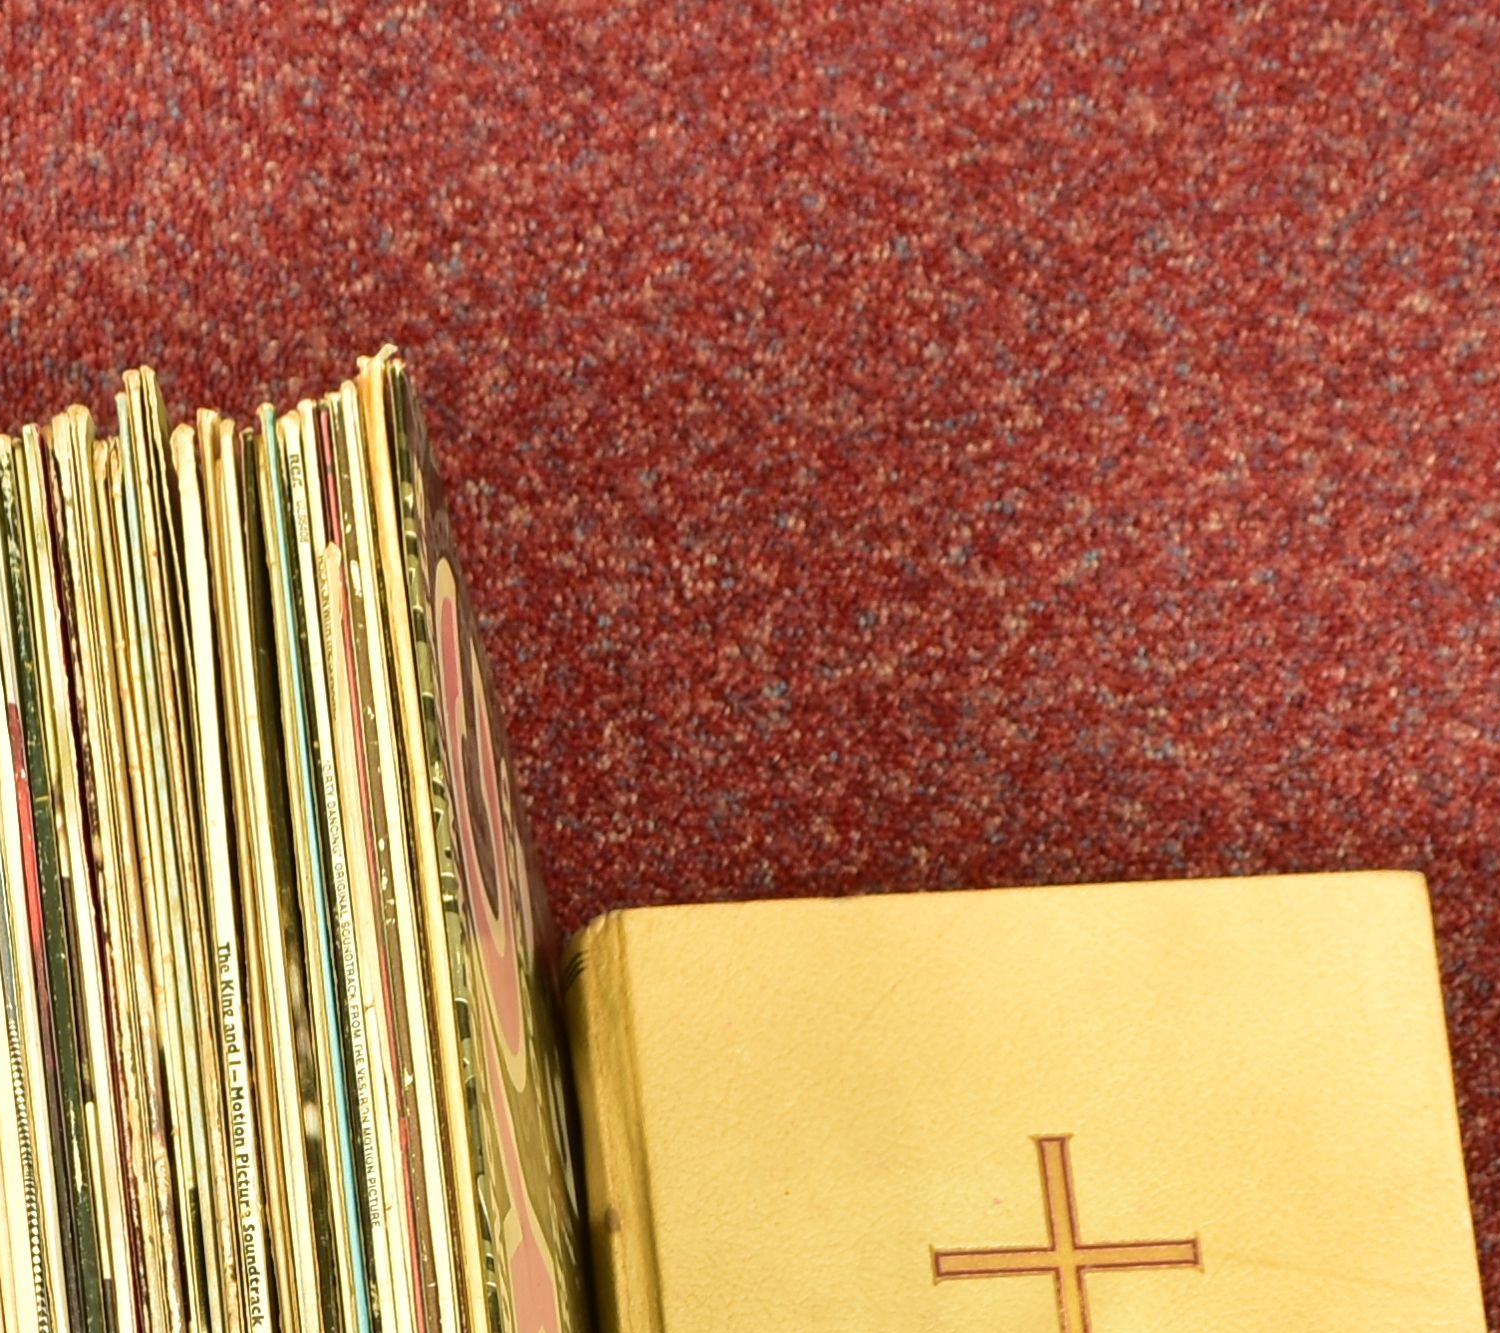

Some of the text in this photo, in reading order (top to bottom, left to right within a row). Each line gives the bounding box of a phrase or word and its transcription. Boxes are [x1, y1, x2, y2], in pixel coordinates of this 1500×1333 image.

[217, 942, 231, 973] The
[219, 980, 235, 1018] King
[225, 1024, 238, 1054] and
[242, 1224, 265, 1327] Soundtrack
